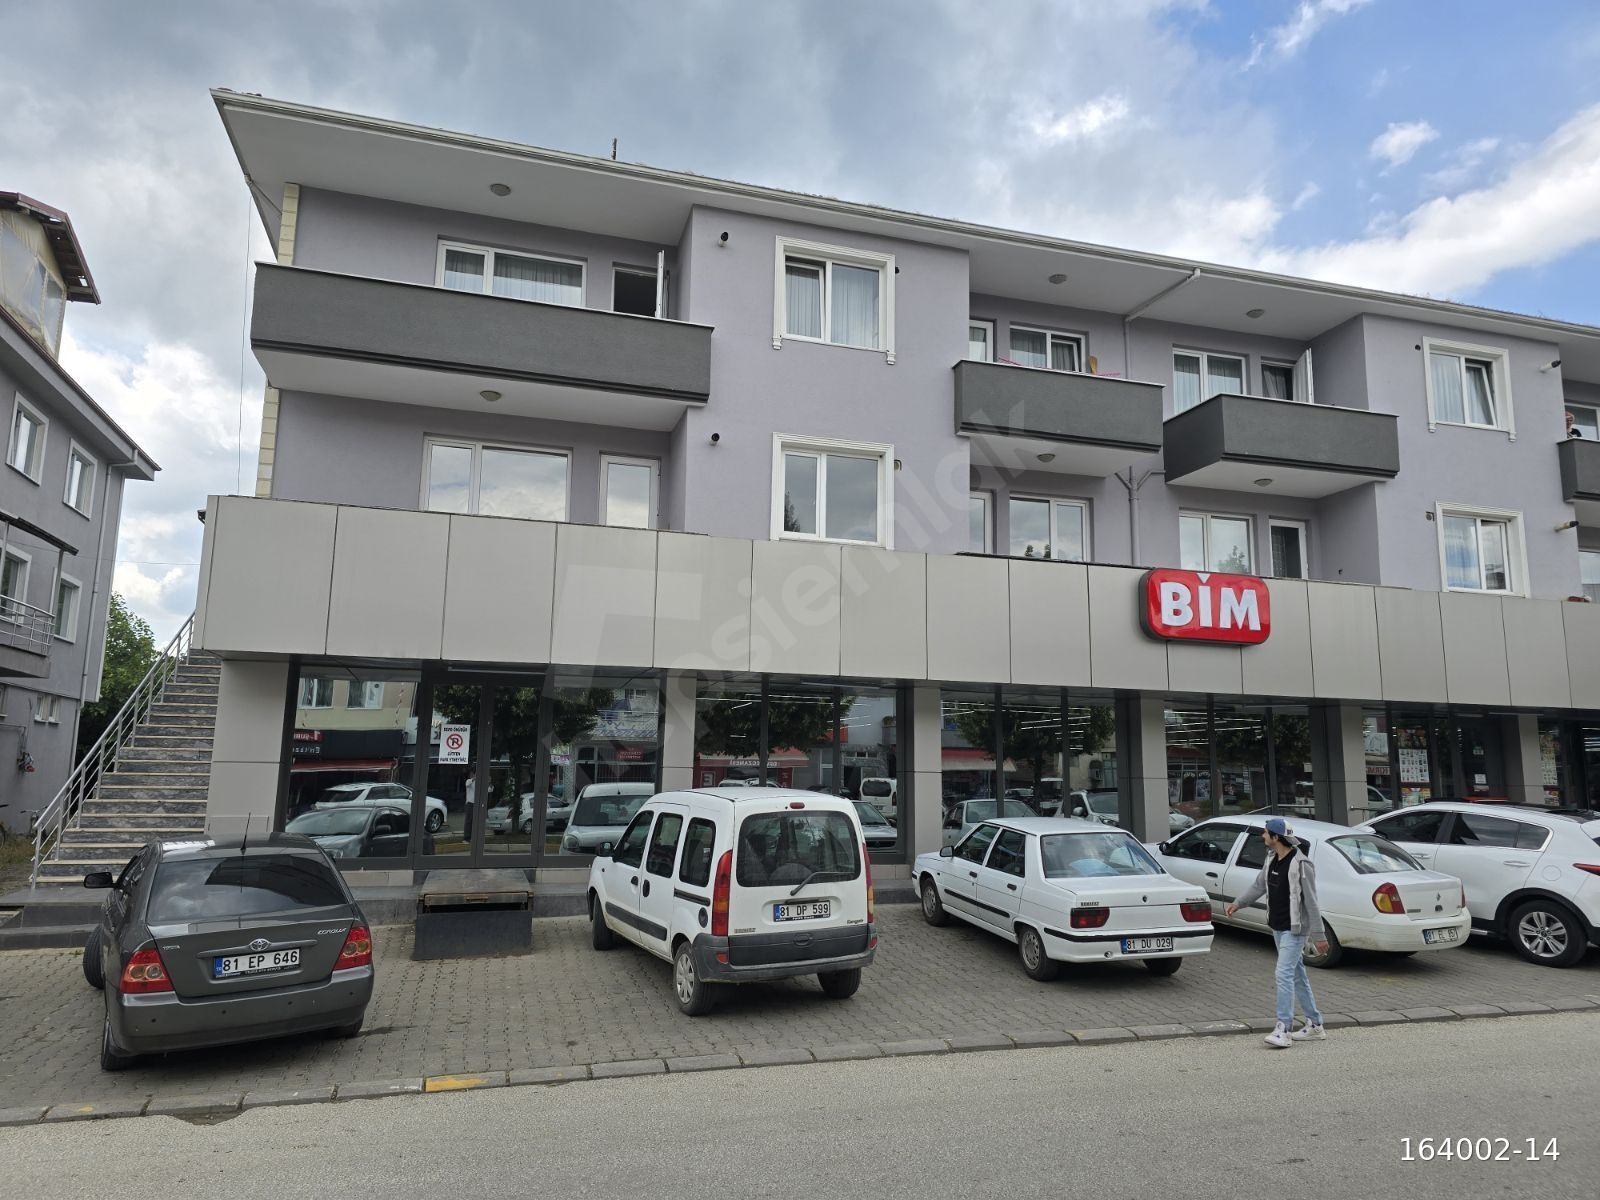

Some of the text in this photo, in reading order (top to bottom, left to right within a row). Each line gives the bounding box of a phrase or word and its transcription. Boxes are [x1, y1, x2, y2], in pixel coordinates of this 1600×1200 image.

[780, 903, 829, 917] 81 DP 599
[1126, 938, 1171, 950] 81 DU 029
[222, 958, 239, 972] 81
[249, 955, 265, 969] EP
[273, 950, 298, 965] 646
